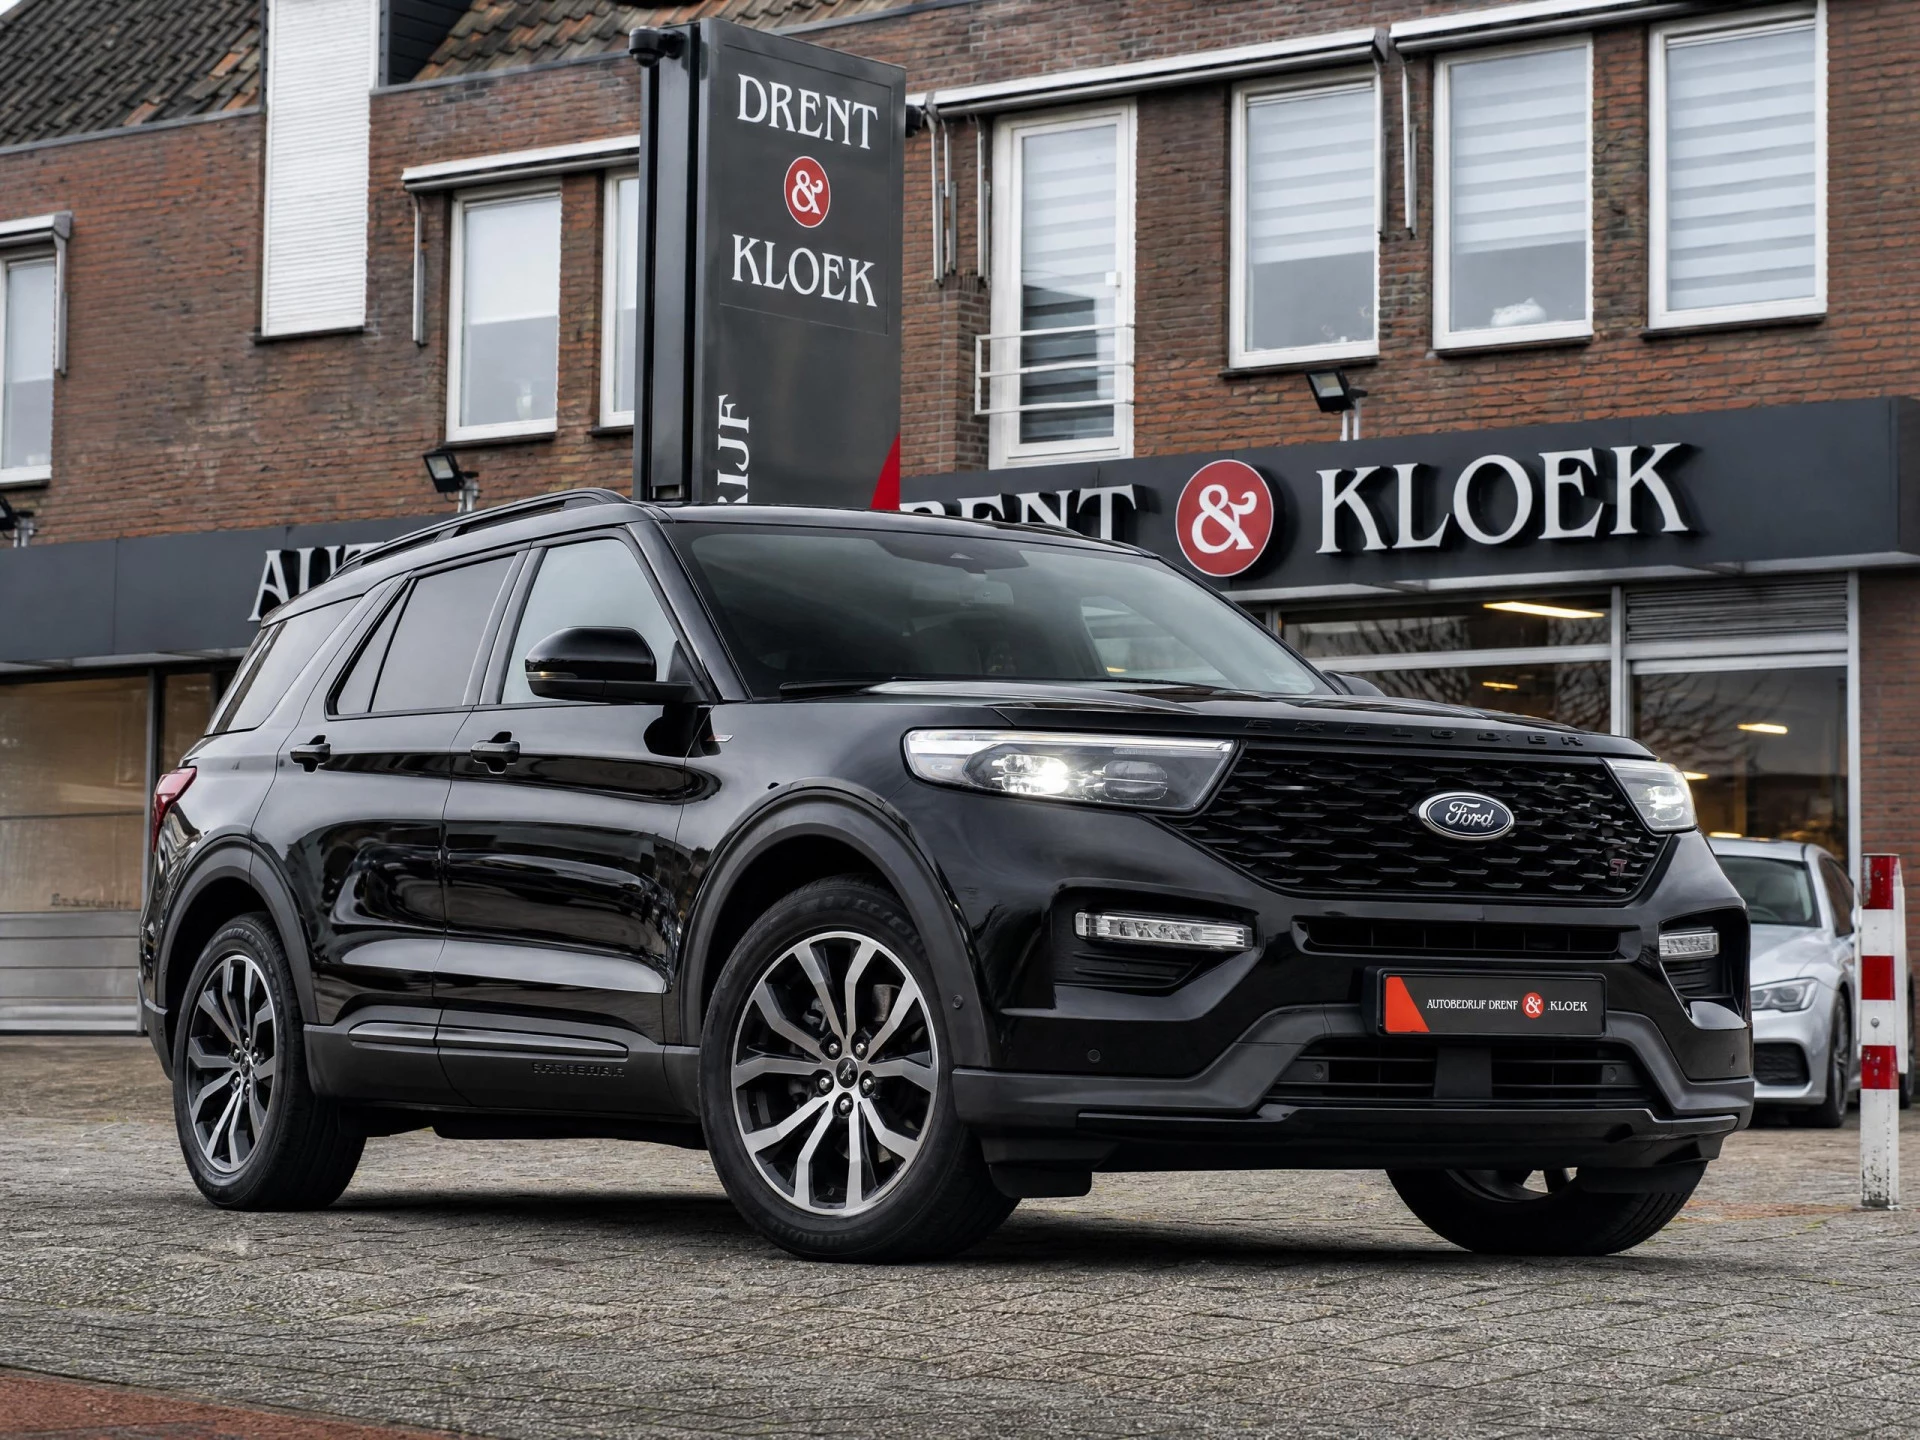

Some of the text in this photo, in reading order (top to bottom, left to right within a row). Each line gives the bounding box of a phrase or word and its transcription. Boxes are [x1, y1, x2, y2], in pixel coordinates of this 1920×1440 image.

[737, 73, 879, 150] DRENT
[791, 169, 823, 215] &
[731, 233, 878, 307] KLOEK
[717, 393, 750, 504] IJF
[1191, 483, 1257, 554] &
[1316, 441, 1690, 555] KLOEK
[1445, 801, 1495, 828] Ford
[1426, 999, 1487, 1010] AUTOBEDRIJF
[1525, 996, 1542, 1014] &
[1550, 1001, 1588, 1012] KLOEK
